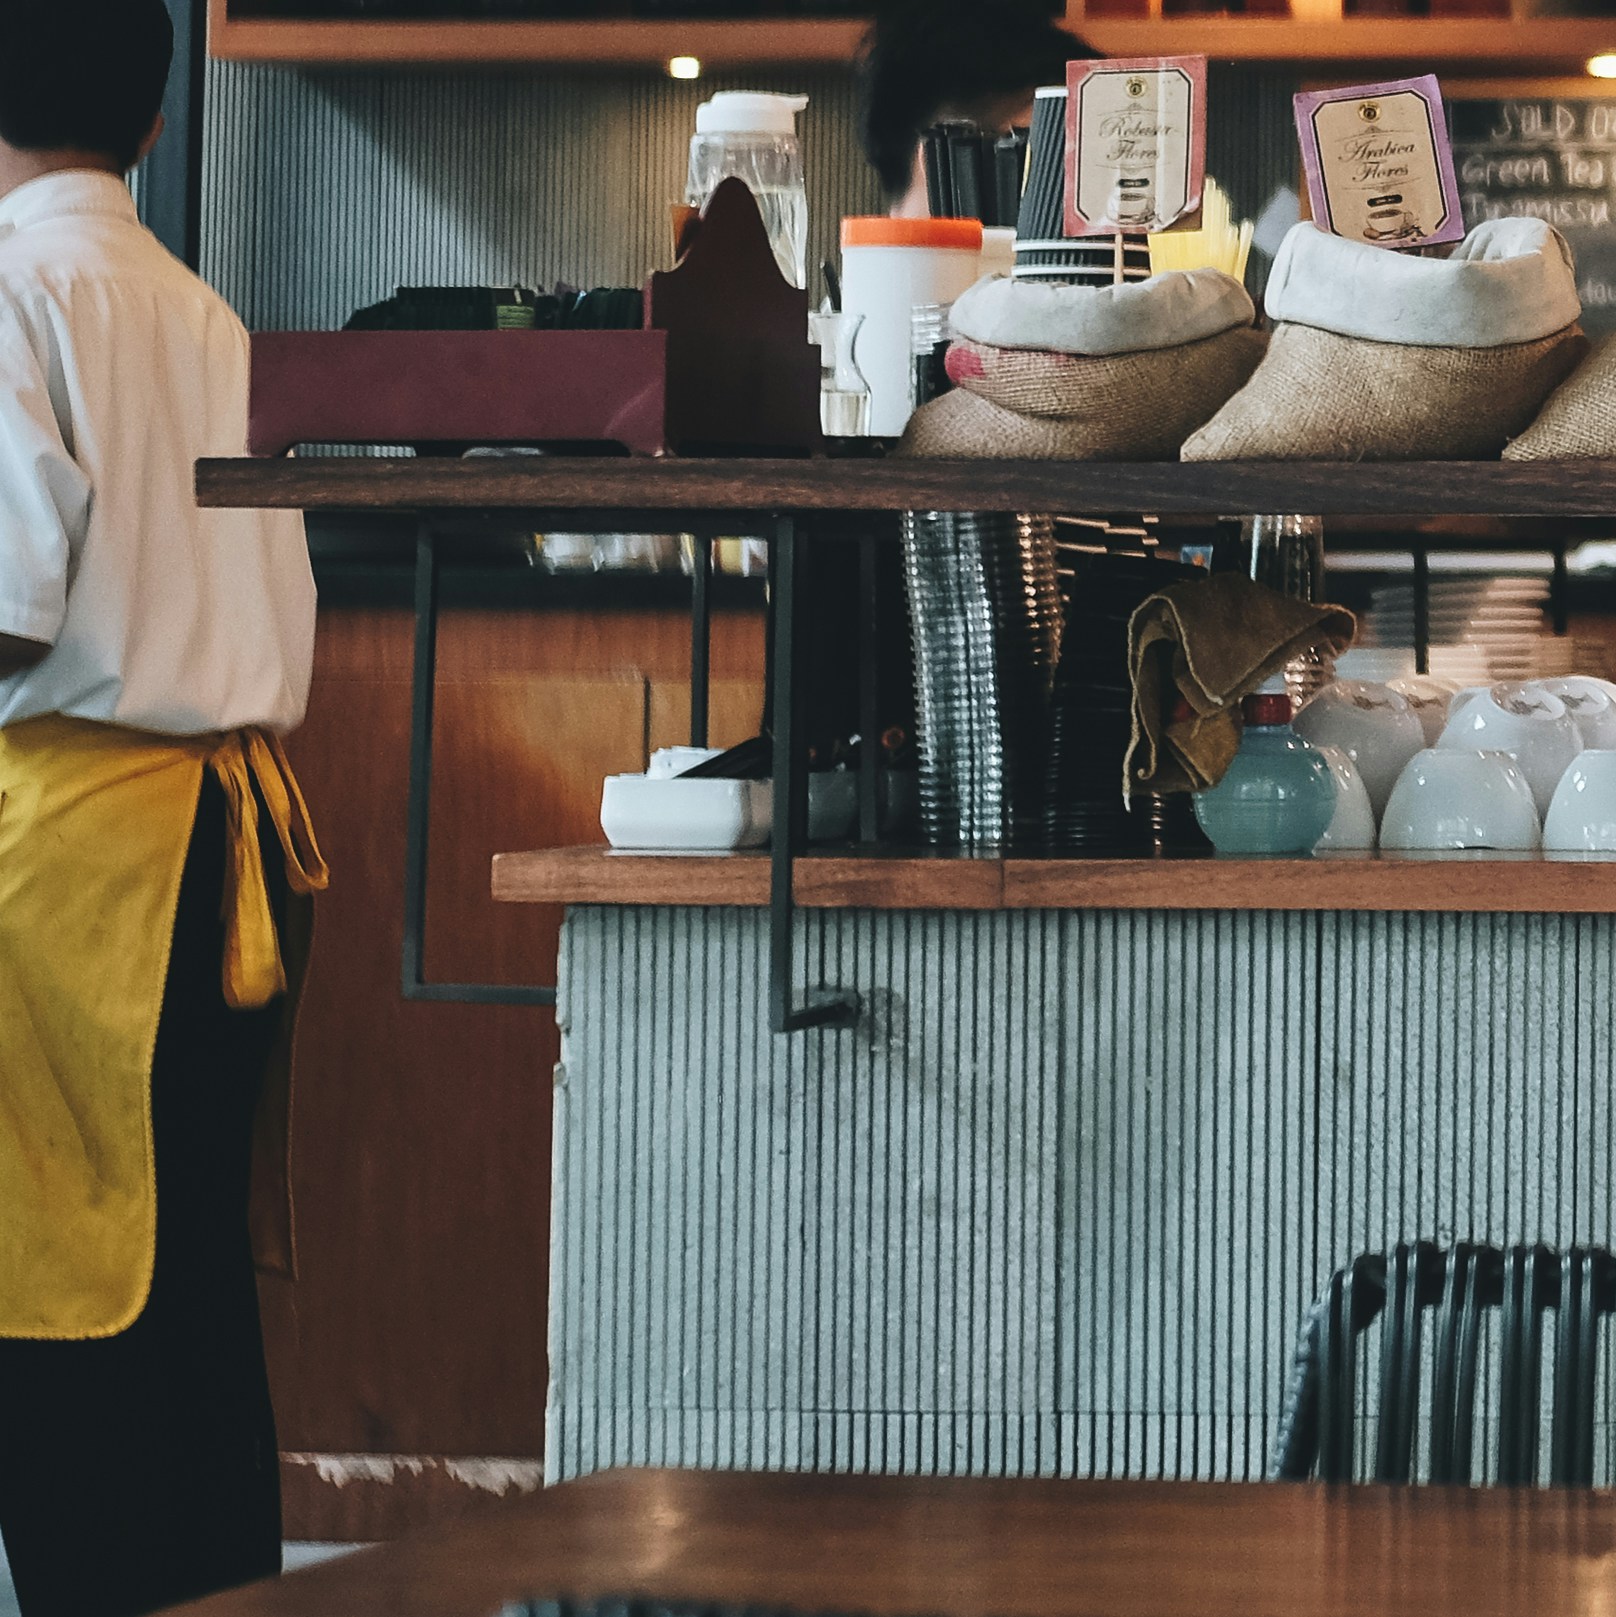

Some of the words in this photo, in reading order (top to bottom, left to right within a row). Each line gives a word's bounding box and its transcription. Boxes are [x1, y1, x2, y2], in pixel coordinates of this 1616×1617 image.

[1492, 104, 1576, 138] SOLD
[1338, 139, 1416, 162] Arabica
[1351, 161, 1409, 182] Flores
